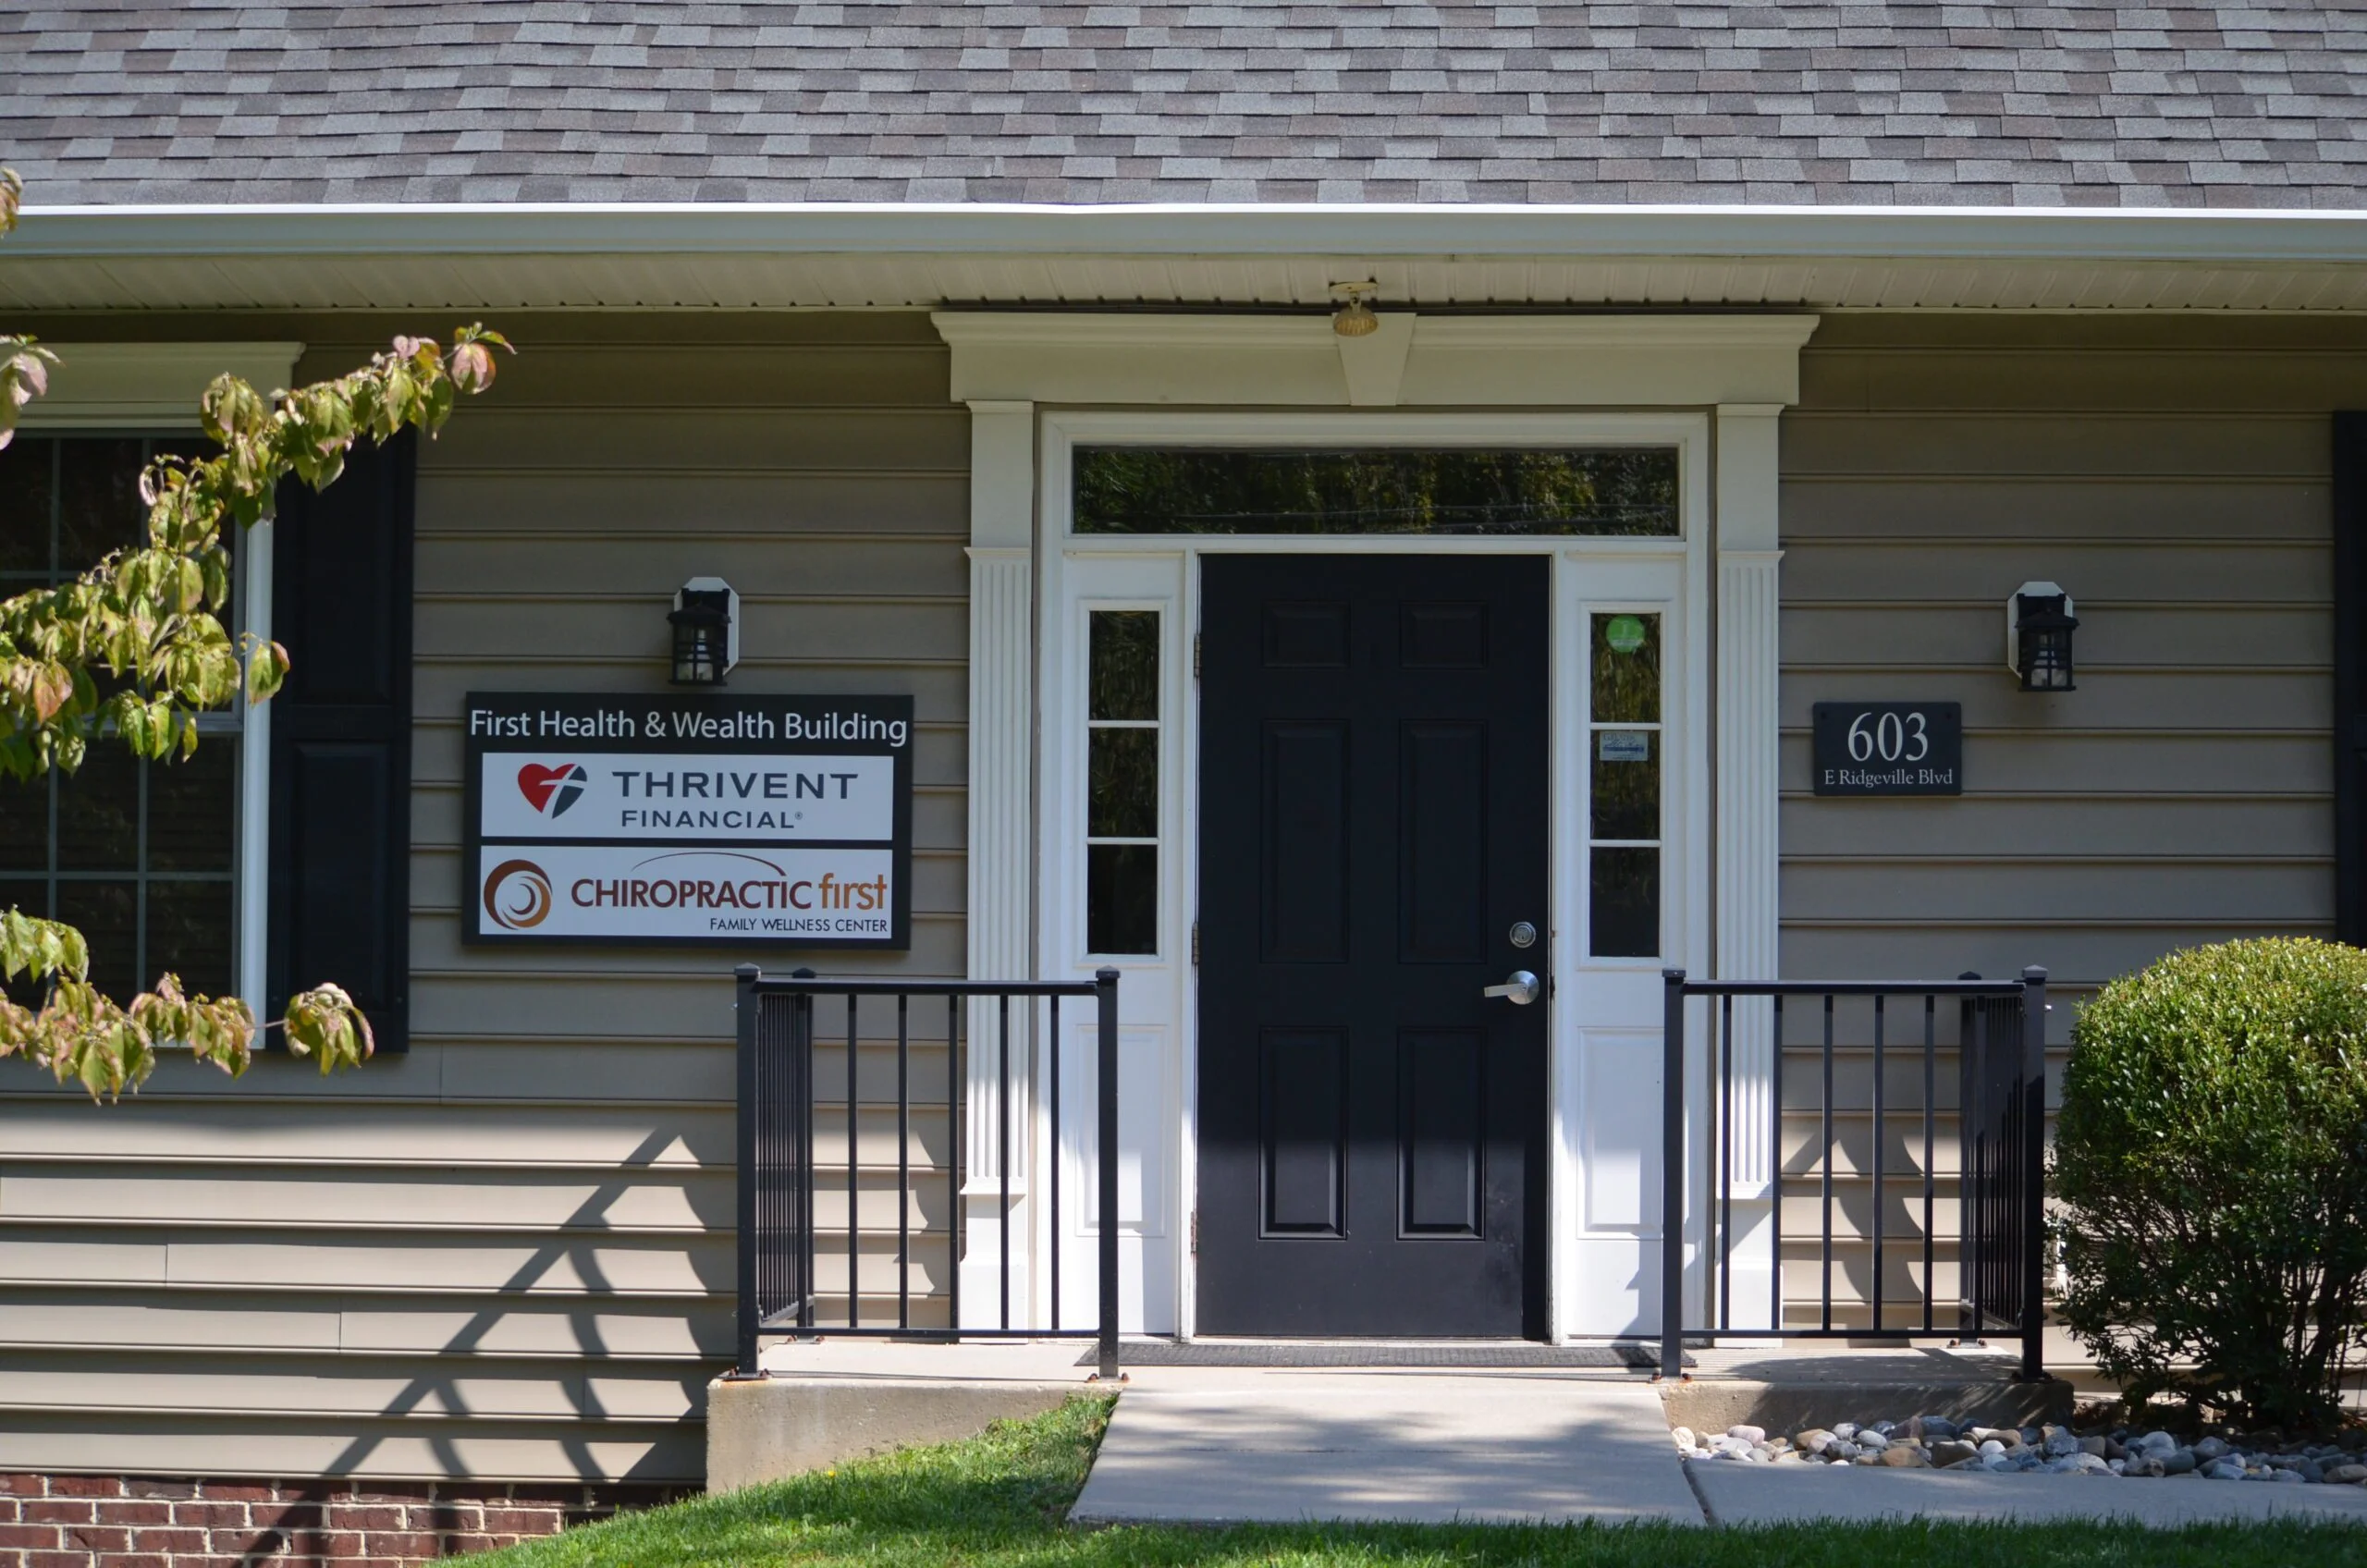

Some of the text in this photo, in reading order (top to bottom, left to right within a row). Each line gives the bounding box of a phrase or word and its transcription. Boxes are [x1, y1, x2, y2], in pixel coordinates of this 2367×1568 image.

[470, 708, 907, 747] First Health & Wealth Building
[1847, 712, 1929, 762] 603
[611, 771, 859, 800] THRIVENT
[1824, 767, 1953, 788] E Ridgeville Blvd
[570, 873, 888, 910] CHIROPRACTIC first
[710, 917, 888, 933] FAMILY WELLNESS CENTER
